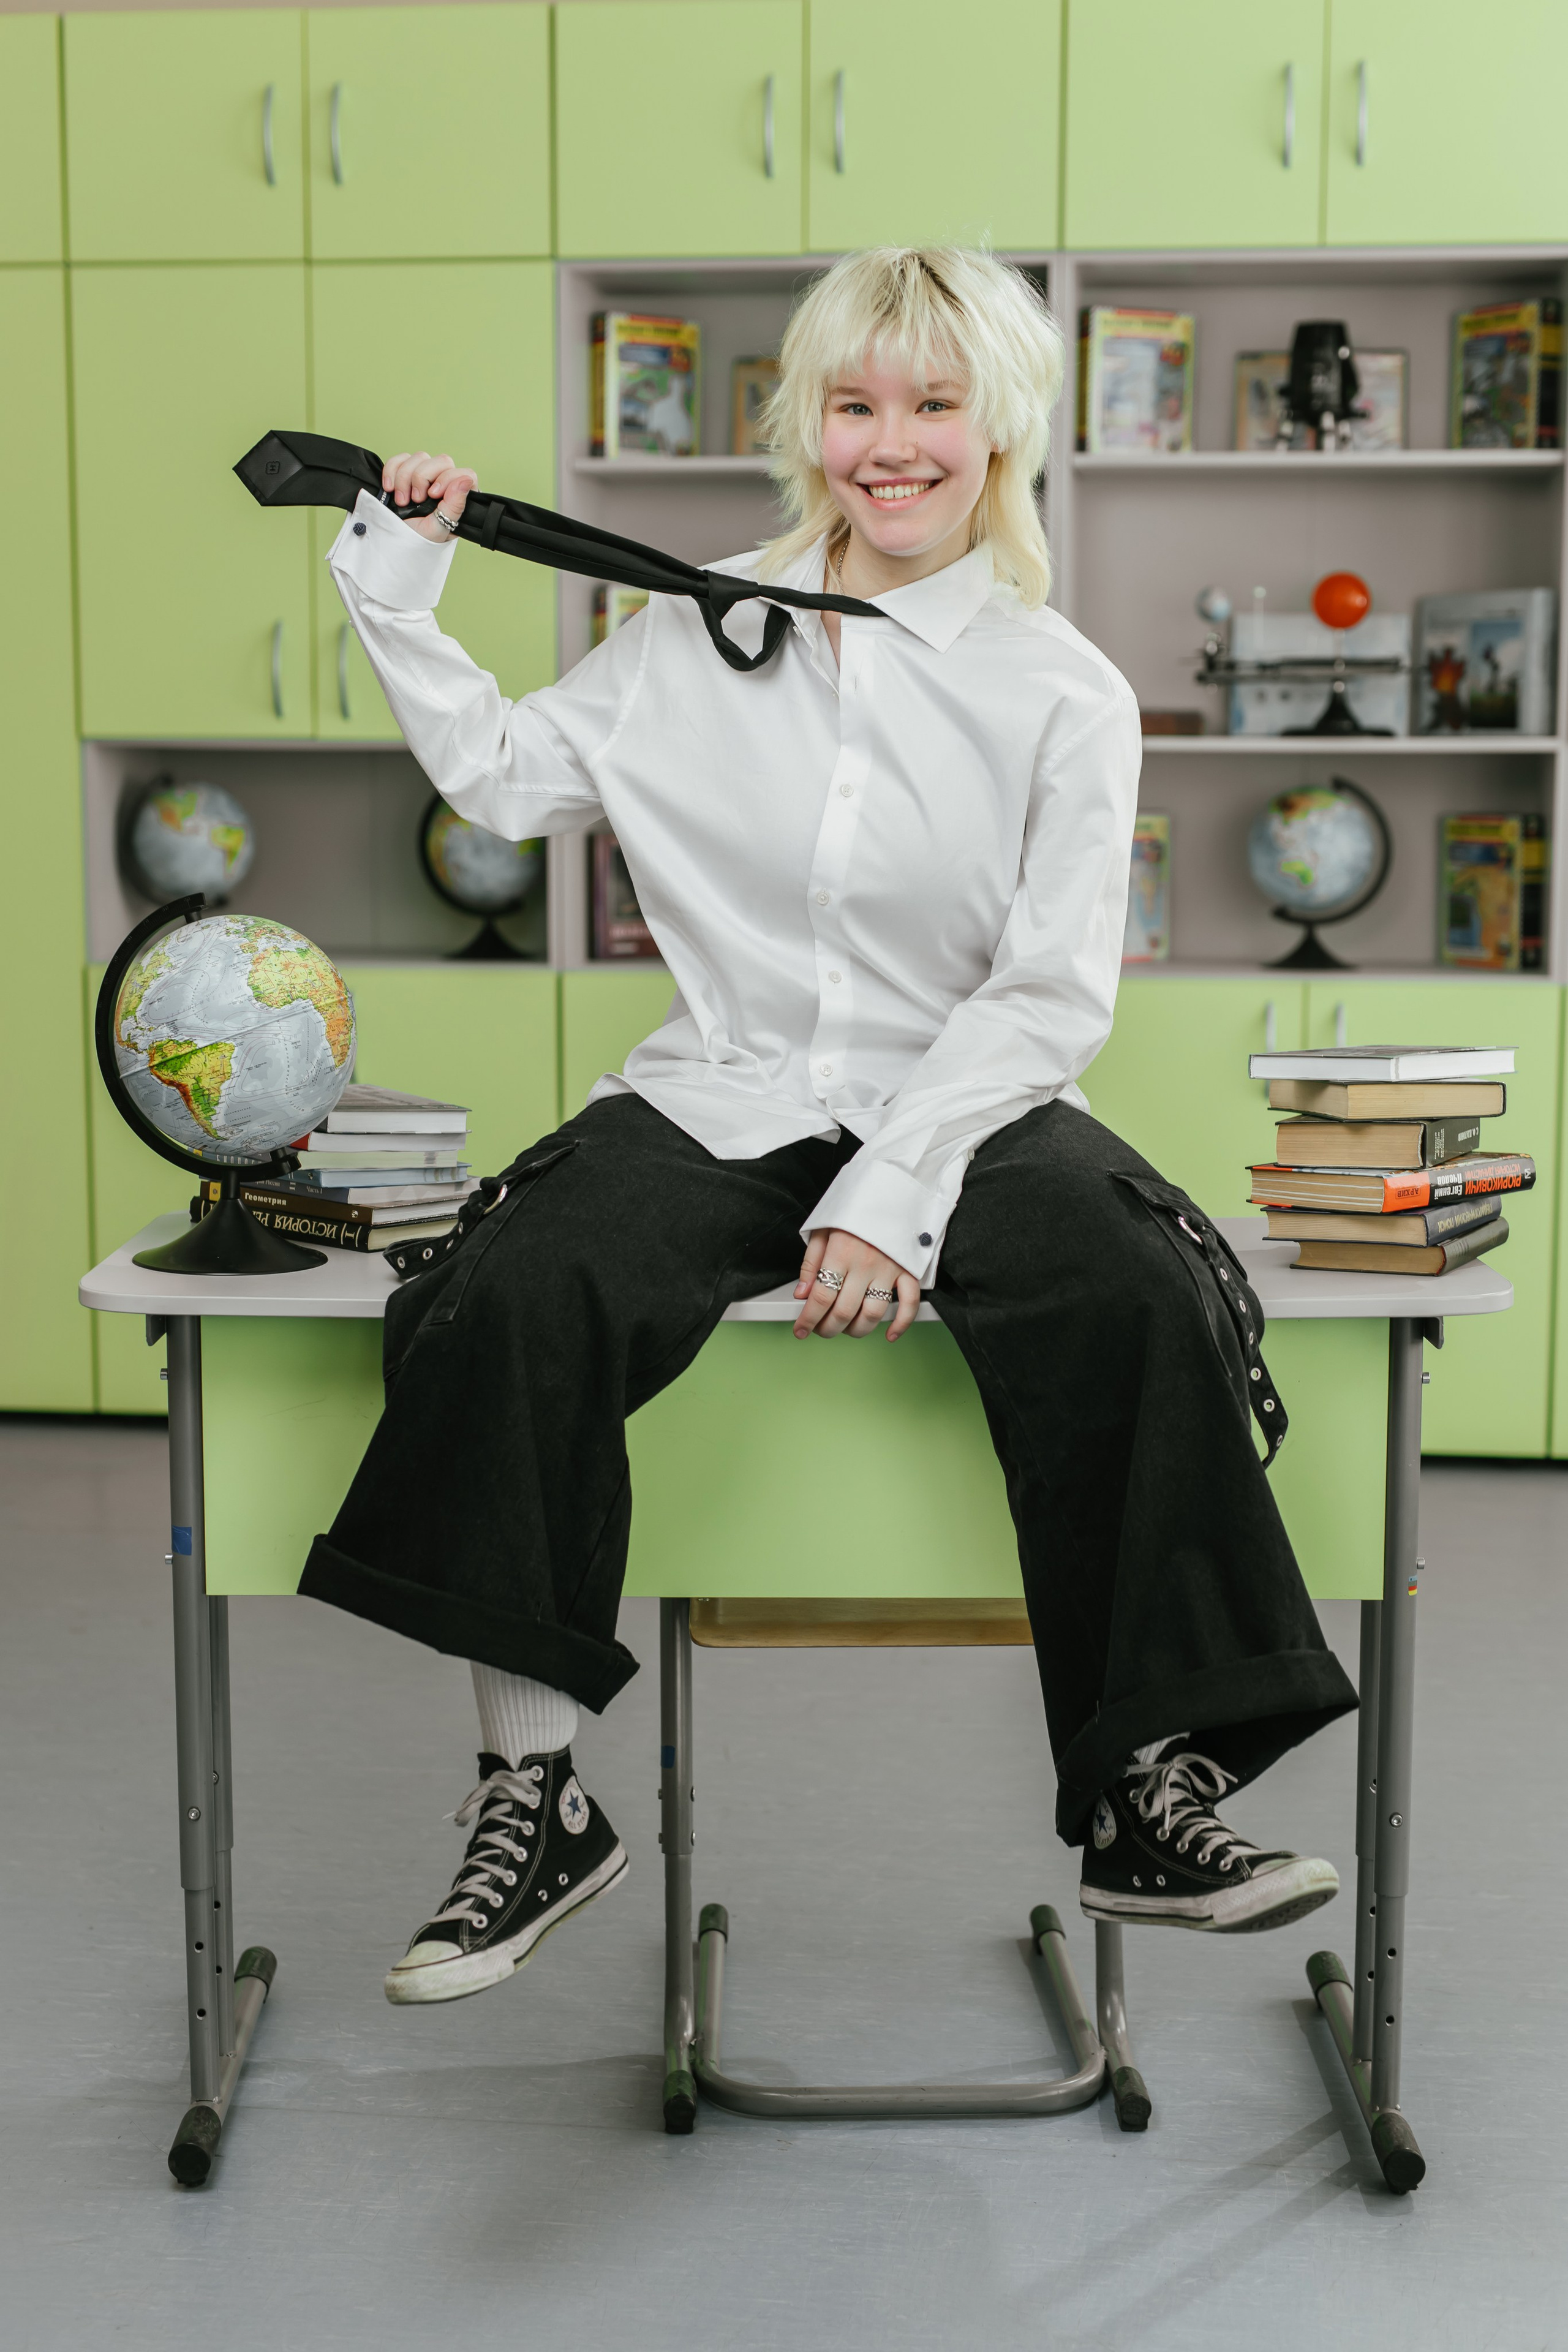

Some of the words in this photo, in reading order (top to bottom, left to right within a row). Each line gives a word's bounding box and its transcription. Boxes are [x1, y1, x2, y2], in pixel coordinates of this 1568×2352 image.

[1464, 1166, 1494, 1180] ДИНАСТИИ
[1494, 1163, 1521, 1176] ИСТОРИЯ
[306, 1185, 319, 1194] Часть
[1464, 1173, 1522, 1195] РЮРИКОВИЧИ
[1397, 1188, 1420, 1198] АРХИВ
[1434, 1184, 1463, 1199] Евгений
[244, 1193, 287, 1206] Геометрия
[273, 1215, 338, 1239] ИСТОРИЯ
[1437, 1216, 1454, 1233] ПОИСК
[567, 1820, 576, 1829] ALL
